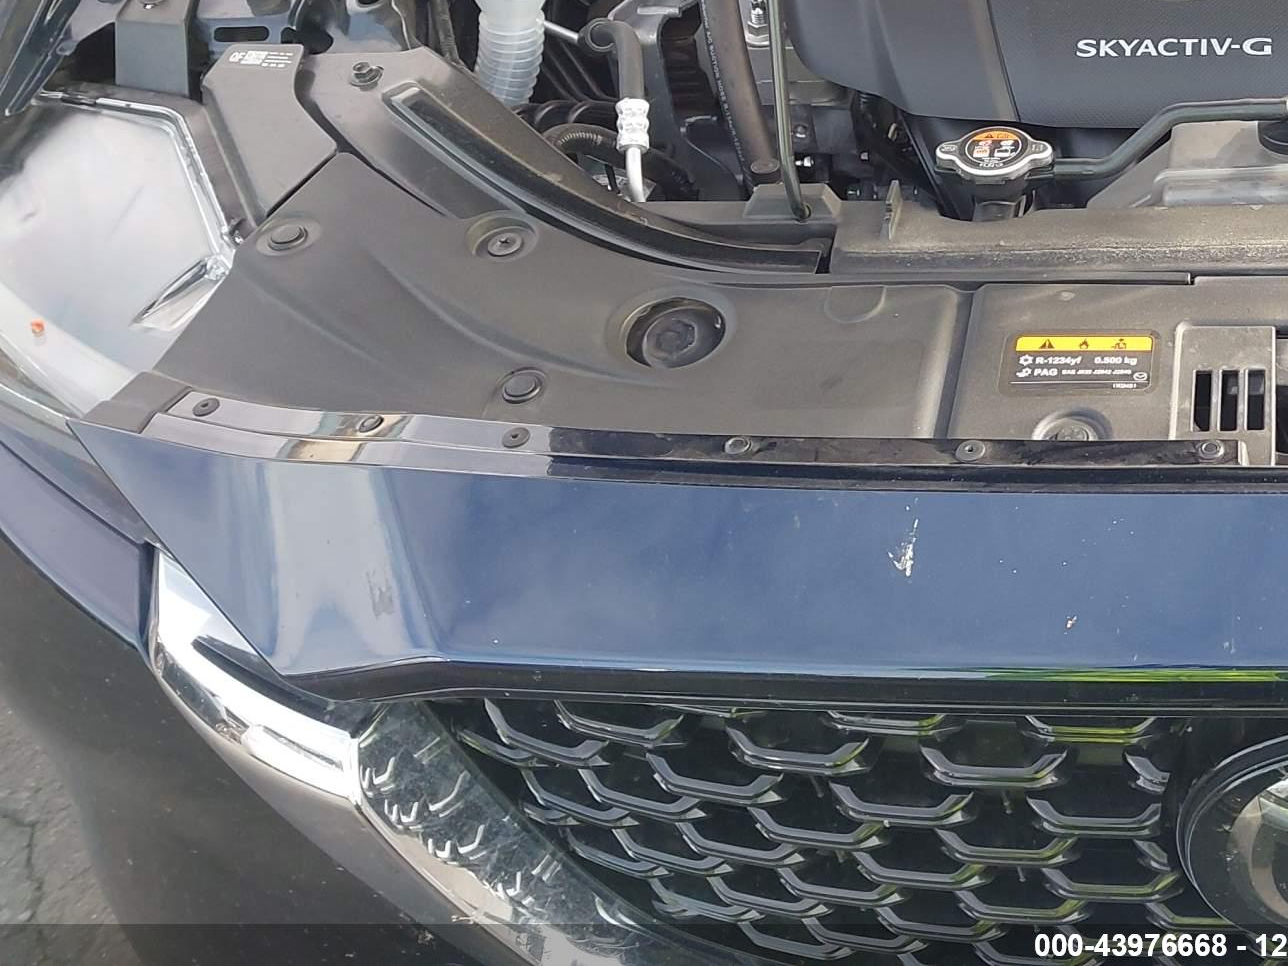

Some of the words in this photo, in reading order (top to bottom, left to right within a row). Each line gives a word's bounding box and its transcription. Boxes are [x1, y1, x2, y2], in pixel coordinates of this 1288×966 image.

[1075, 37, 1273, 58] SKYACTIV-G
[1035, 356, 1082, 366] R-1234yf
[1094, 356, 1122, 365] 0.500
[1123, 356, 1138, 366] kg
[1033, 368, 1058, 376] PAG
